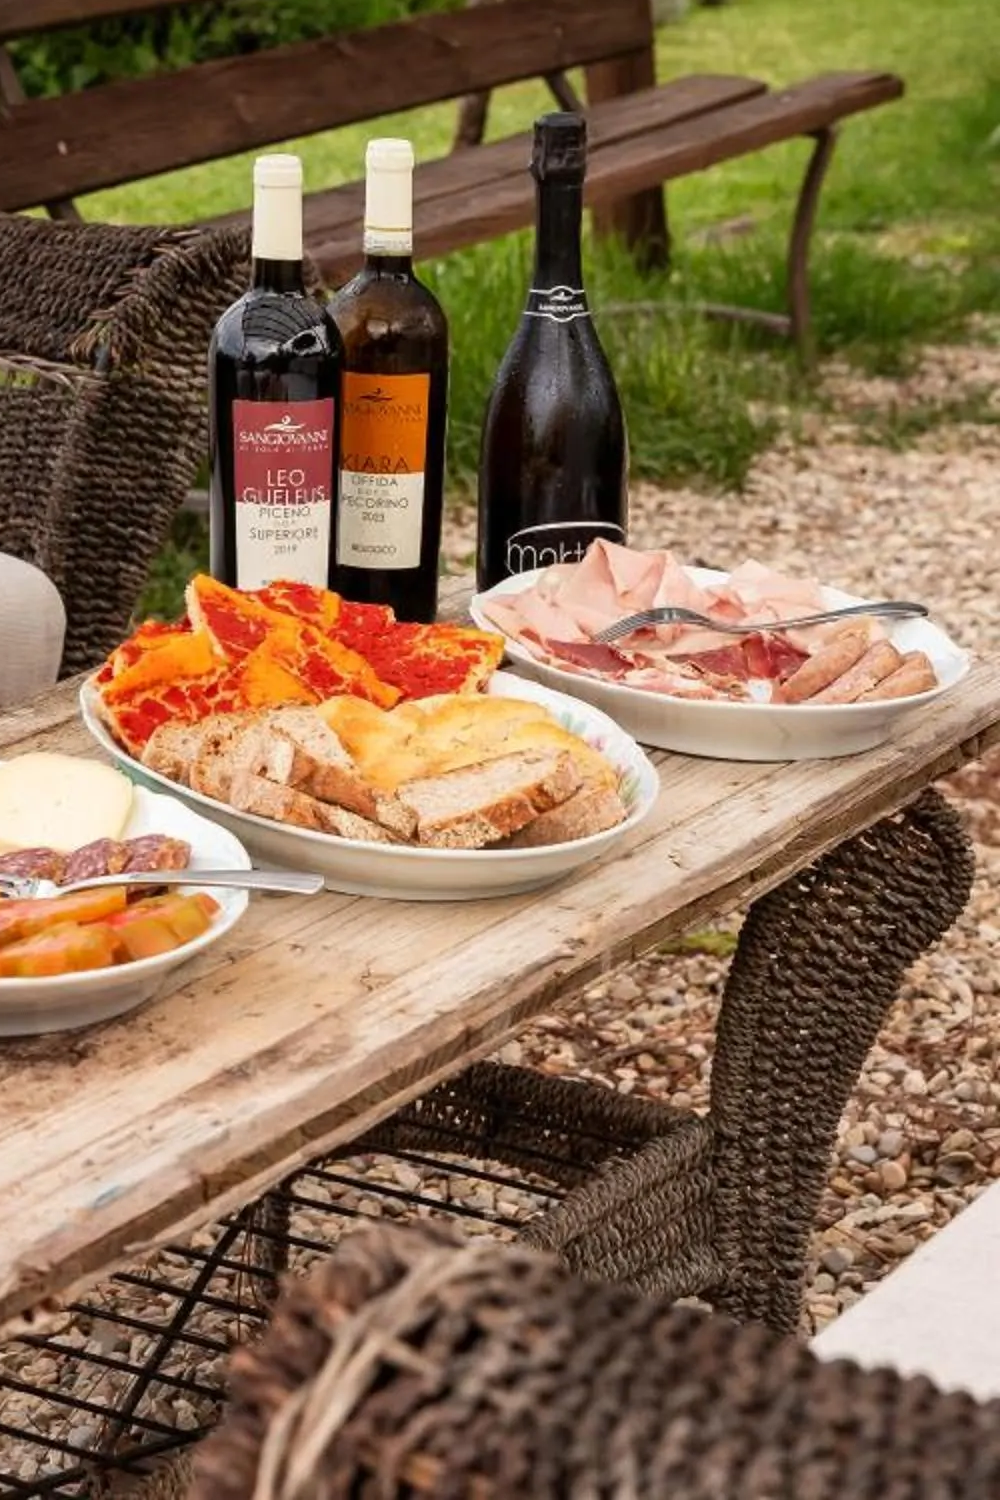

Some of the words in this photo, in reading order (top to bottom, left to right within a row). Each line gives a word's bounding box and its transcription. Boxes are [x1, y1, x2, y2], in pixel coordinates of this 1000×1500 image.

[239, 429, 328, 445] SANGIOVANNI
[267, 469, 305, 487] LEO
[259, 504, 311, 519] PICENO
[248, 526, 319, 541] SUPERIORE
